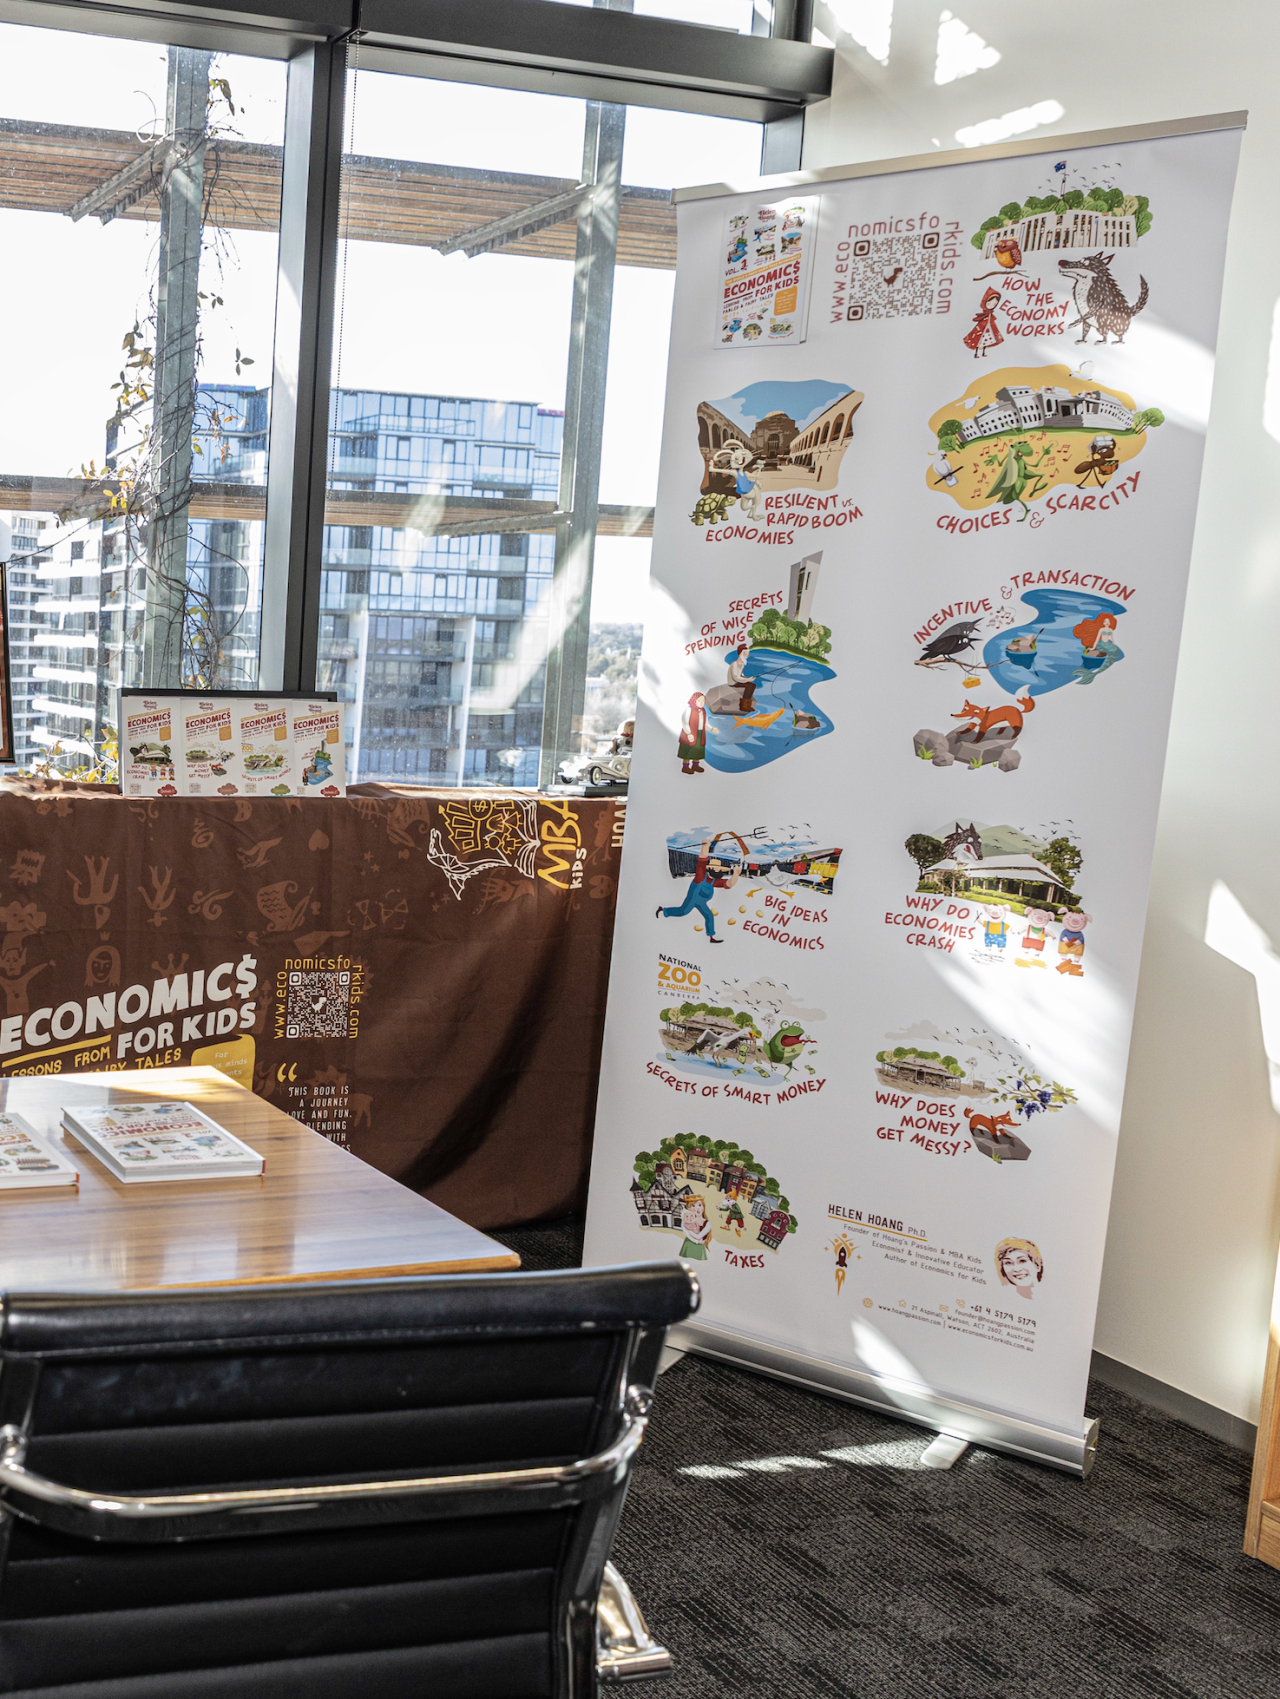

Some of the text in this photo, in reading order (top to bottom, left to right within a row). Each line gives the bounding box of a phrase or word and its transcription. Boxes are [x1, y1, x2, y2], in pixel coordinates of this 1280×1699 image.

[755, 276, 799, 297] FOR KIDS
[1002, 277, 1041, 291] HOW
[1026, 292, 1054, 306] THE
[999, 300, 1070, 322] ECONOMY
[1006, 322, 1065, 337] WORKS
[765, 493, 839, 511] RESILIENT
[936, 471, 1141, 534] CHOICES & SCARCITY
[766, 506, 864, 529] RAPID BOOM
[705, 525, 795, 545] ECONOMIES
[729, 590, 783, 613] SECRETS
[913, 570, 1136, 644] INCENTIVE & TRANSACTION
[701, 611, 754, 636] OF WISE
[685, 630, 746, 656] SPENDING
[765, 895, 828, 923] BIG IDEAS
[905, 895, 970, 920] WHY DO
[772, 913, 790, 927] IN
[885, 912, 976, 940] ECONOMIES
[742, 920, 825, 951] ECONOMICS
[906, 933, 956, 954] CRASH
[658, 953, 702, 972] NATIONAL
[657, 962, 701, 987] ZOO
[657, 980, 701, 994] & AQUARIUM
[657, 990, 700, 1001] CANBERRA
[117, 1002, 257, 1059] FOR KIDS
[3, 1059, 62, 1078] ESSONS
[74, 1046, 111, 1067] FROM
[135, 1047, 182, 1070] TALES
[226, 1058, 248, 1067] minds
[288, 1086, 349, 1097] THIS BOOK IS
[646, 1061, 827, 1105] SECRETS OF SMART MONEY
[299, 1098, 348, 1107] A JOURNEY
[875, 1091, 956, 1117] WHY DOES
[311, 1110, 328, 1119] AND
[334, 1109, 352, 1118] FUN.
[326, 1133, 346, 1141] WITH
[900, 1115, 961, 1137] MONEY
[876, 1126, 972, 1157] GET MESSY?
[828, 1203, 928, 1238] HELEN HOANG Ph.D.
[843, 1223, 869, 1236] Founder
[882, 1233, 908, 1245] Hoang's
[911, 1241, 937, 1253] Passion
[949, 1250, 963, 1259] MBA
[967, 1255, 982, 1264] Kids
[724, 1250, 765, 1268] TAXES
[872, 1240, 904, 1254] Economist
[915, 1252, 951, 1266] Innovative
[953, 1261, 984, 1274] Educator
[884, 1253, 907, 1264] Author
[920, 1262, 954, 1277] Economics
[958, 1272, 969, 1280] for
[972, 1276, 987, 1285] Kids
[878, 1304, 941, 1326] www.hoangpassion.com
[955, 1309, 1036, 1336] founder@hoangpassion.com
[994, 1310, 1014, 1321] 5179
[1017, 1316, 1036, 1328] 5179
[973, 1322, 985, 1330] ACT
[1006, 1331, 1035, 1344] Australia
